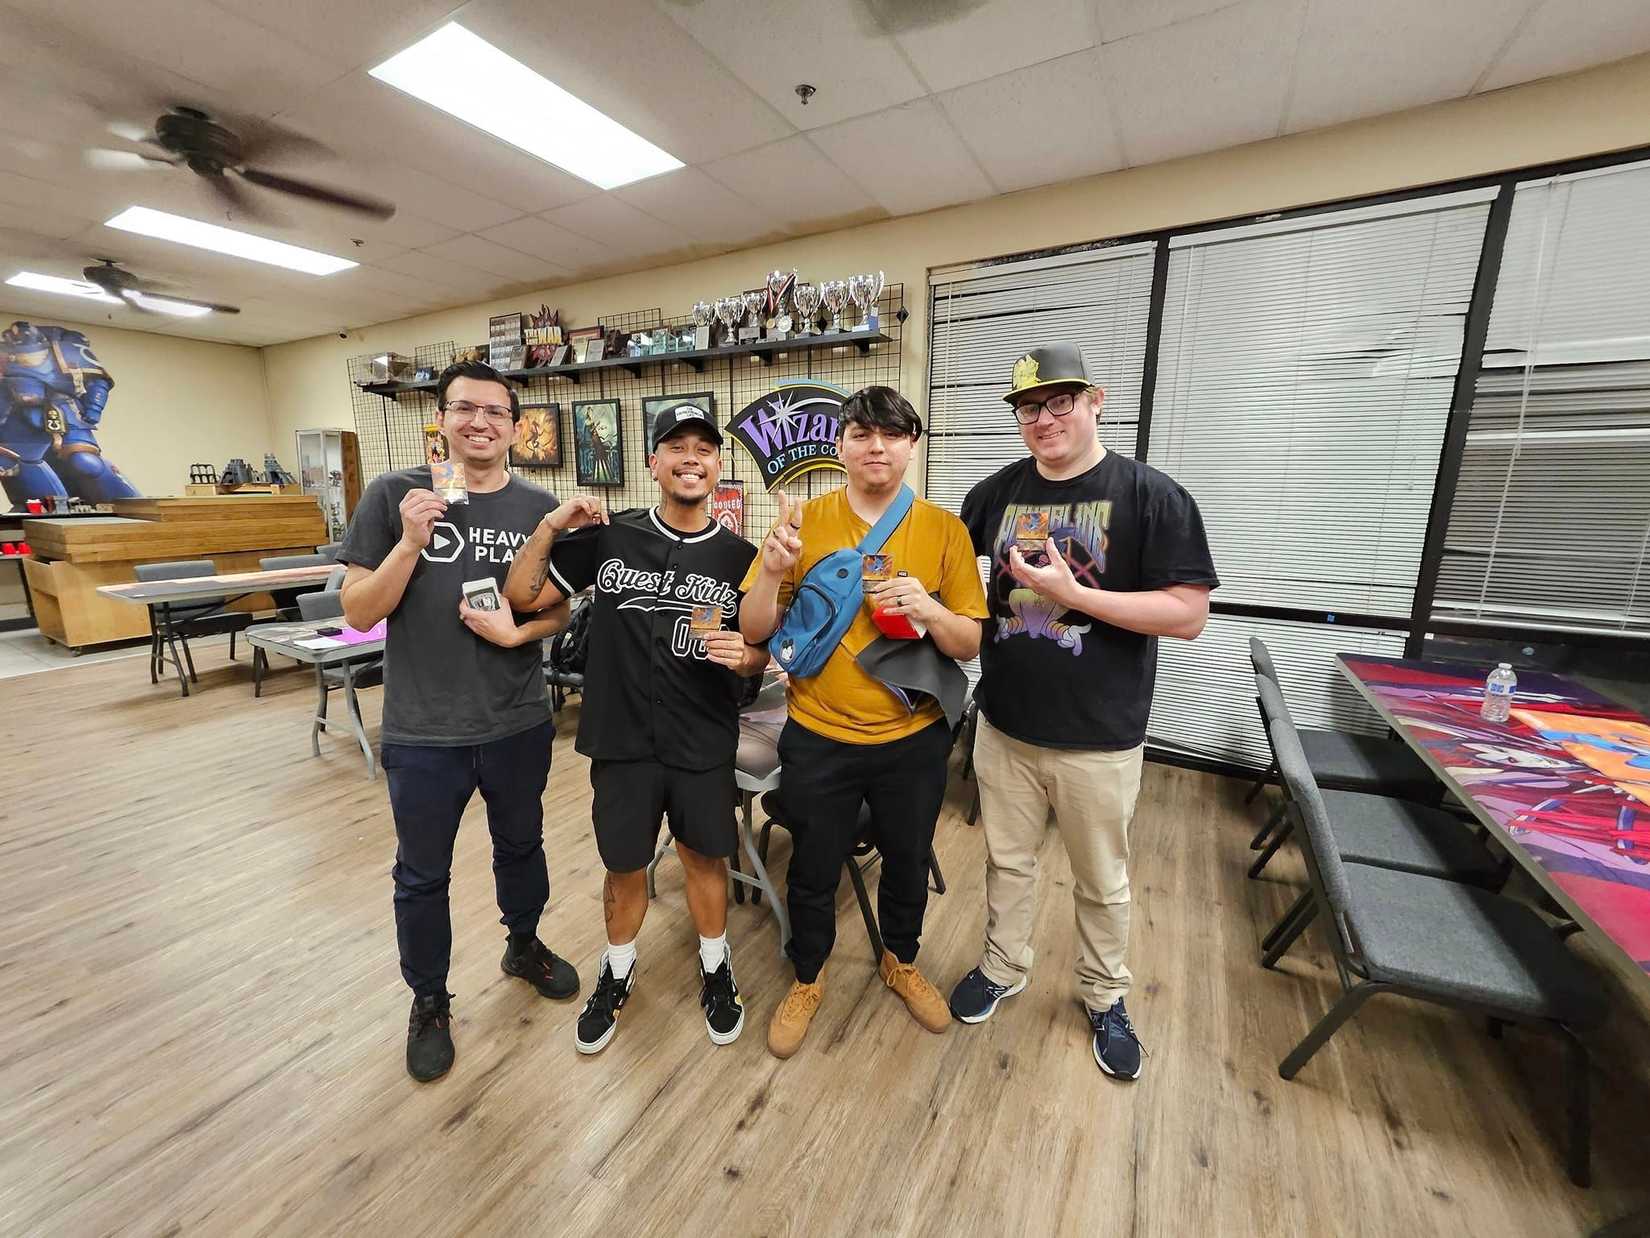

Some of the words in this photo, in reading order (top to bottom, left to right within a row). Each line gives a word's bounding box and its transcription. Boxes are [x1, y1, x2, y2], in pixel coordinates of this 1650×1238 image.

[767, 454, 786, 474] OF
[788, 445, 817, 461] THE
[474, 546, 518, 563] PLA
[597, 558, 676, 596] Quest
[675, 573, 738, 614] Kidz
